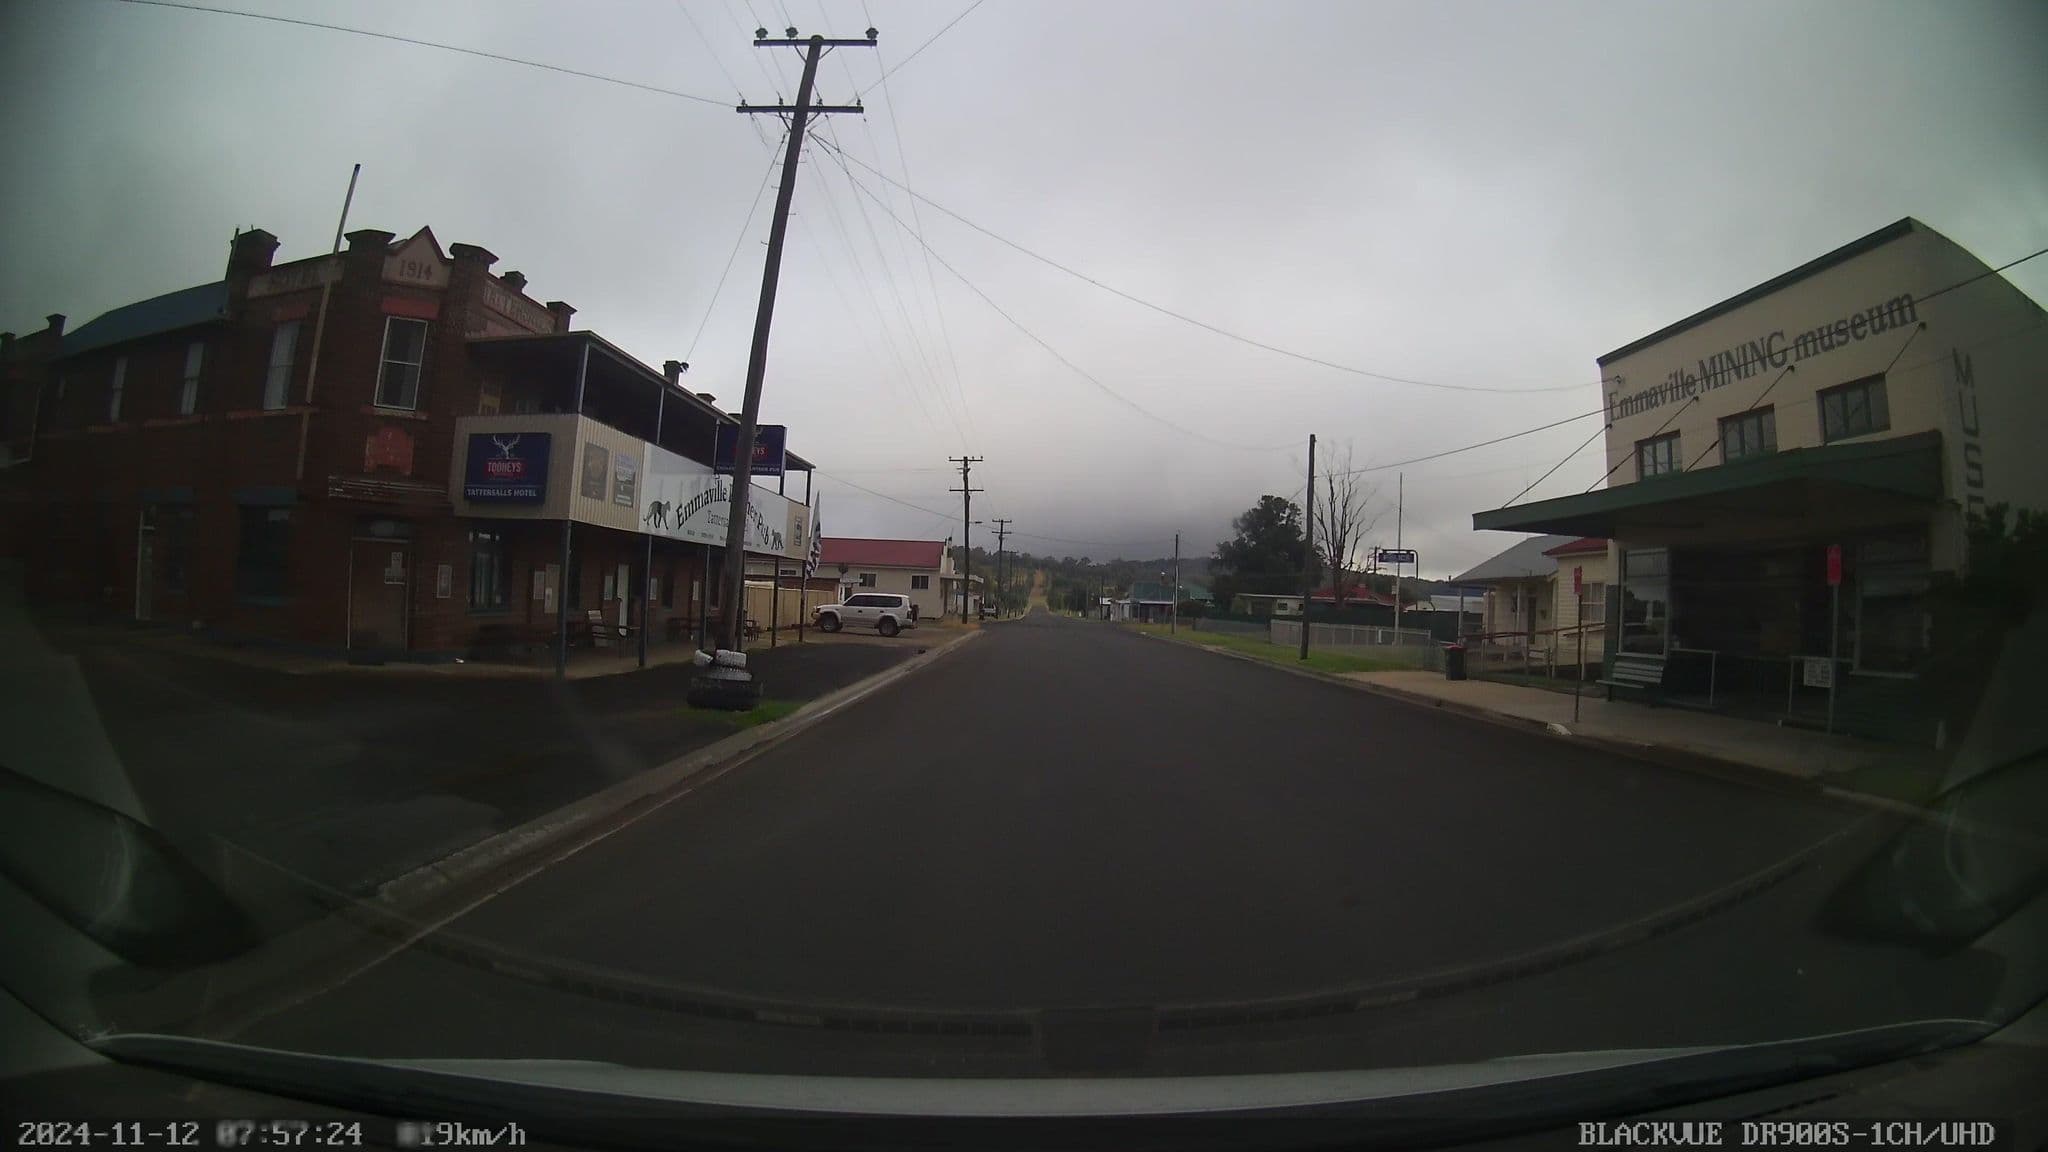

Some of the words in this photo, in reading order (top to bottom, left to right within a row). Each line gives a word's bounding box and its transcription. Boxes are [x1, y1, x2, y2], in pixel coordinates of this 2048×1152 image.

[401, 260, 433, 281] 1914
[1607, 367, 1697, 422] Emmaville
[1698, 330, 1788, 394] MINING
[1794, 292, 1919, 362] museum
[466, 487, 513, 497] TATTERSALLS
[513, 487, 538, 497] HOTEL
[675, 479, 728, 530] Emmaville
[757, 512, 770, 546] Pub
